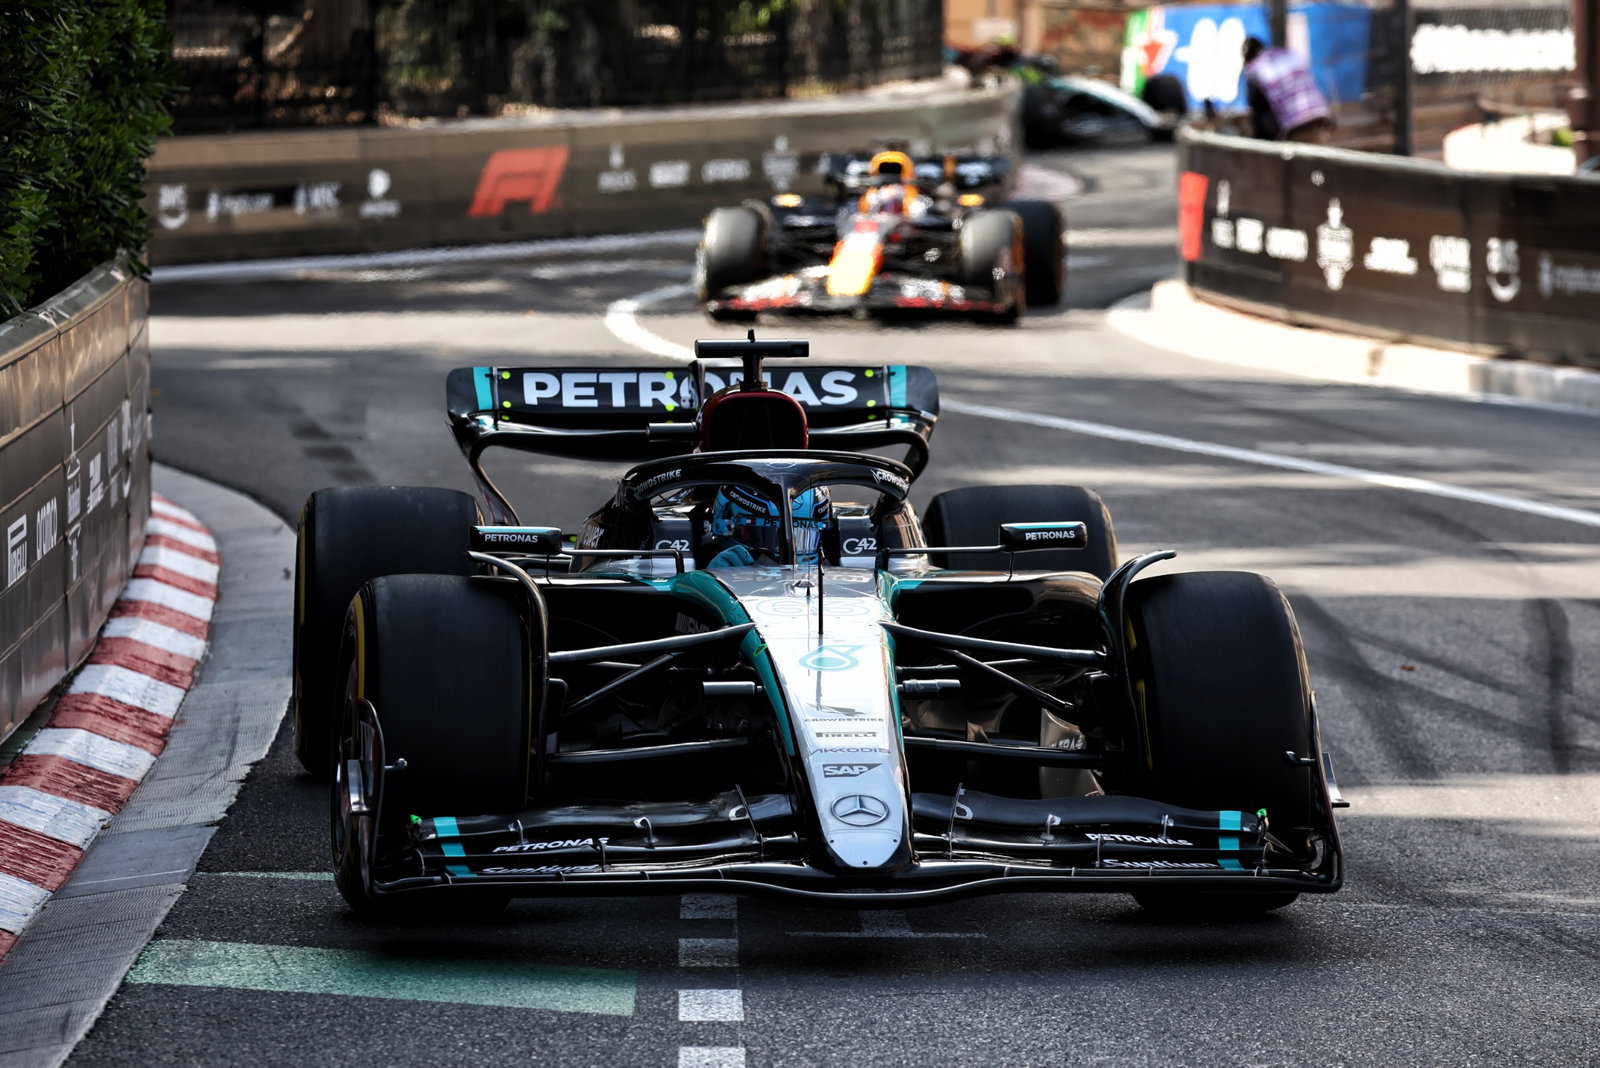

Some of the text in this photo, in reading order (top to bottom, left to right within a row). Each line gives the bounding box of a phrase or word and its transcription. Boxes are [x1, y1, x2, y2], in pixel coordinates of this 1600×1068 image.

[523, 371, 858, 408] PETROAS
[729, 491, 767, 514] CROWDSTRIKE
[484, 534, 539, 543] PETRONAS
[1025, 530, 1076, 540] PETRONAS
[843, 538, 877, 555] G42
[810, 747, 892, 756] AKKODIS
[823, 764, 871, 777] SAP
[492, 837, 610, 853] PETRONAS
[1085, 833, 1194, 846] PETRONAS
